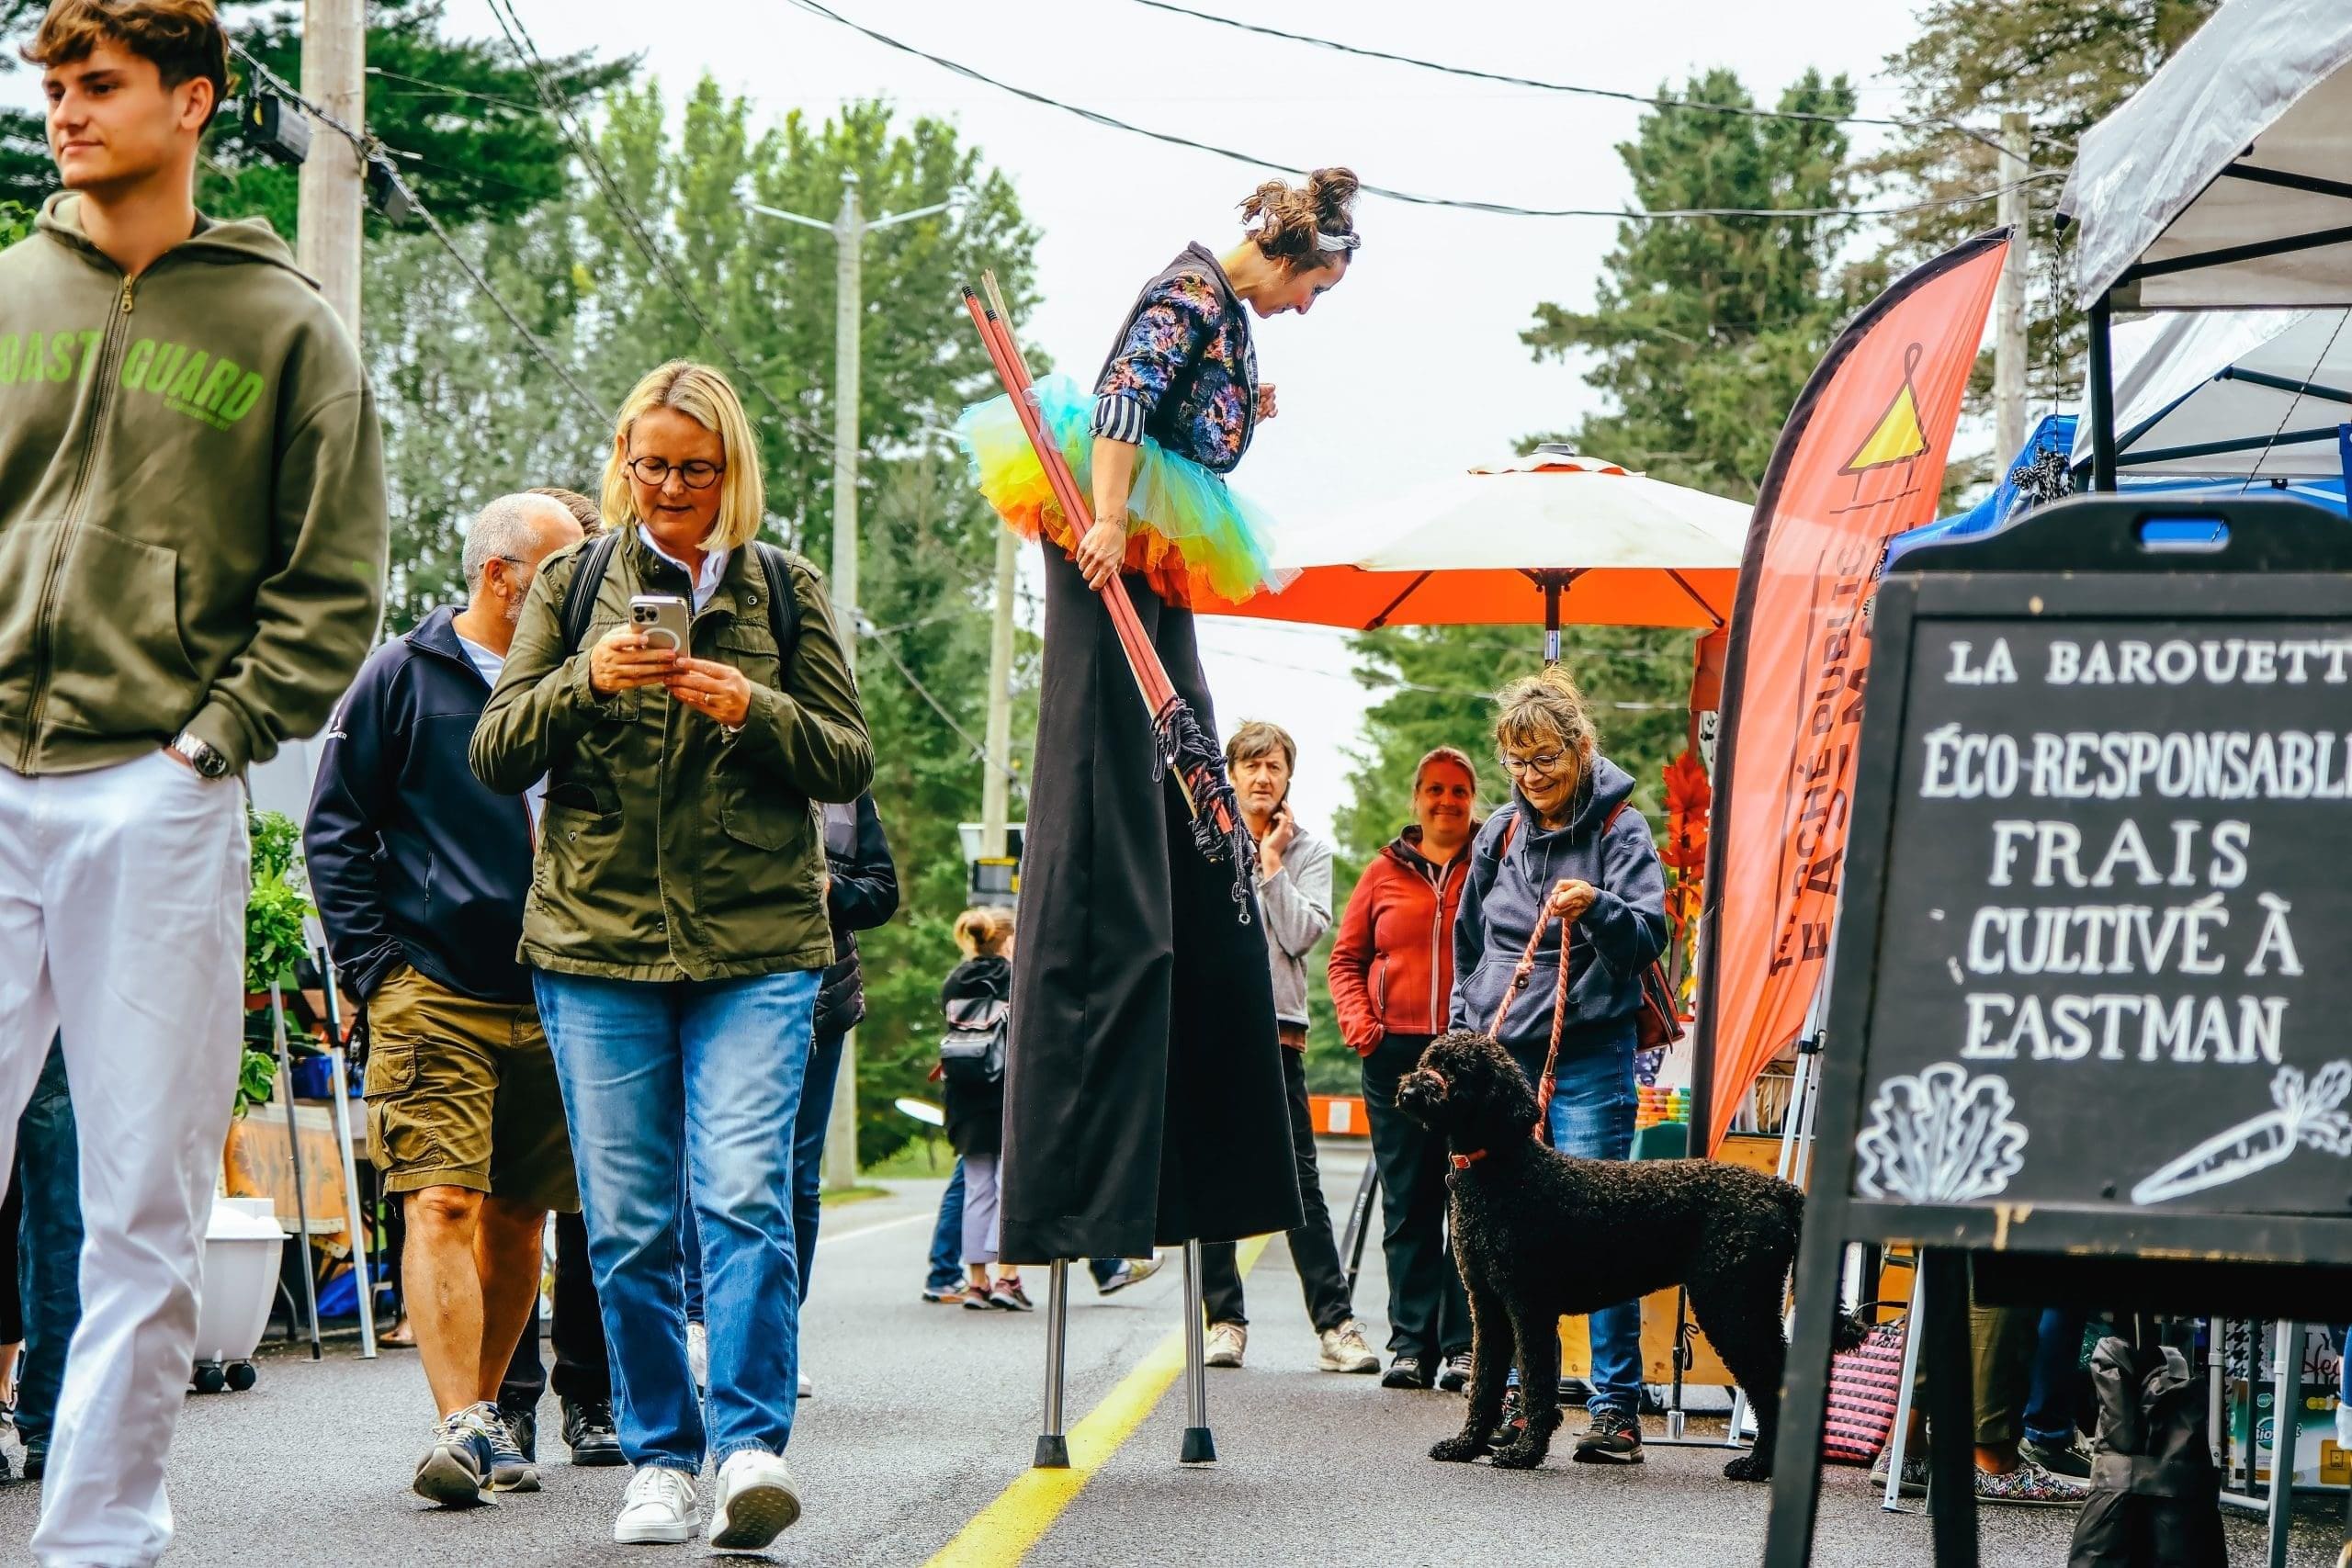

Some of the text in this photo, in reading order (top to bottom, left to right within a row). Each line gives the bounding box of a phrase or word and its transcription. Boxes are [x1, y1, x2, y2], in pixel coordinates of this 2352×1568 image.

[119, 337, 266, 423] GUARD
[1811, 542, 1866, 736] PUBLIC
[1944, 637, 2018, 685] LA
[1988, 818, 2251, 889] FRAIS
[1966, 892, 2304, 976] CULTIVÉ À
[1960, 992, 2290, 1066] EASTMAN
